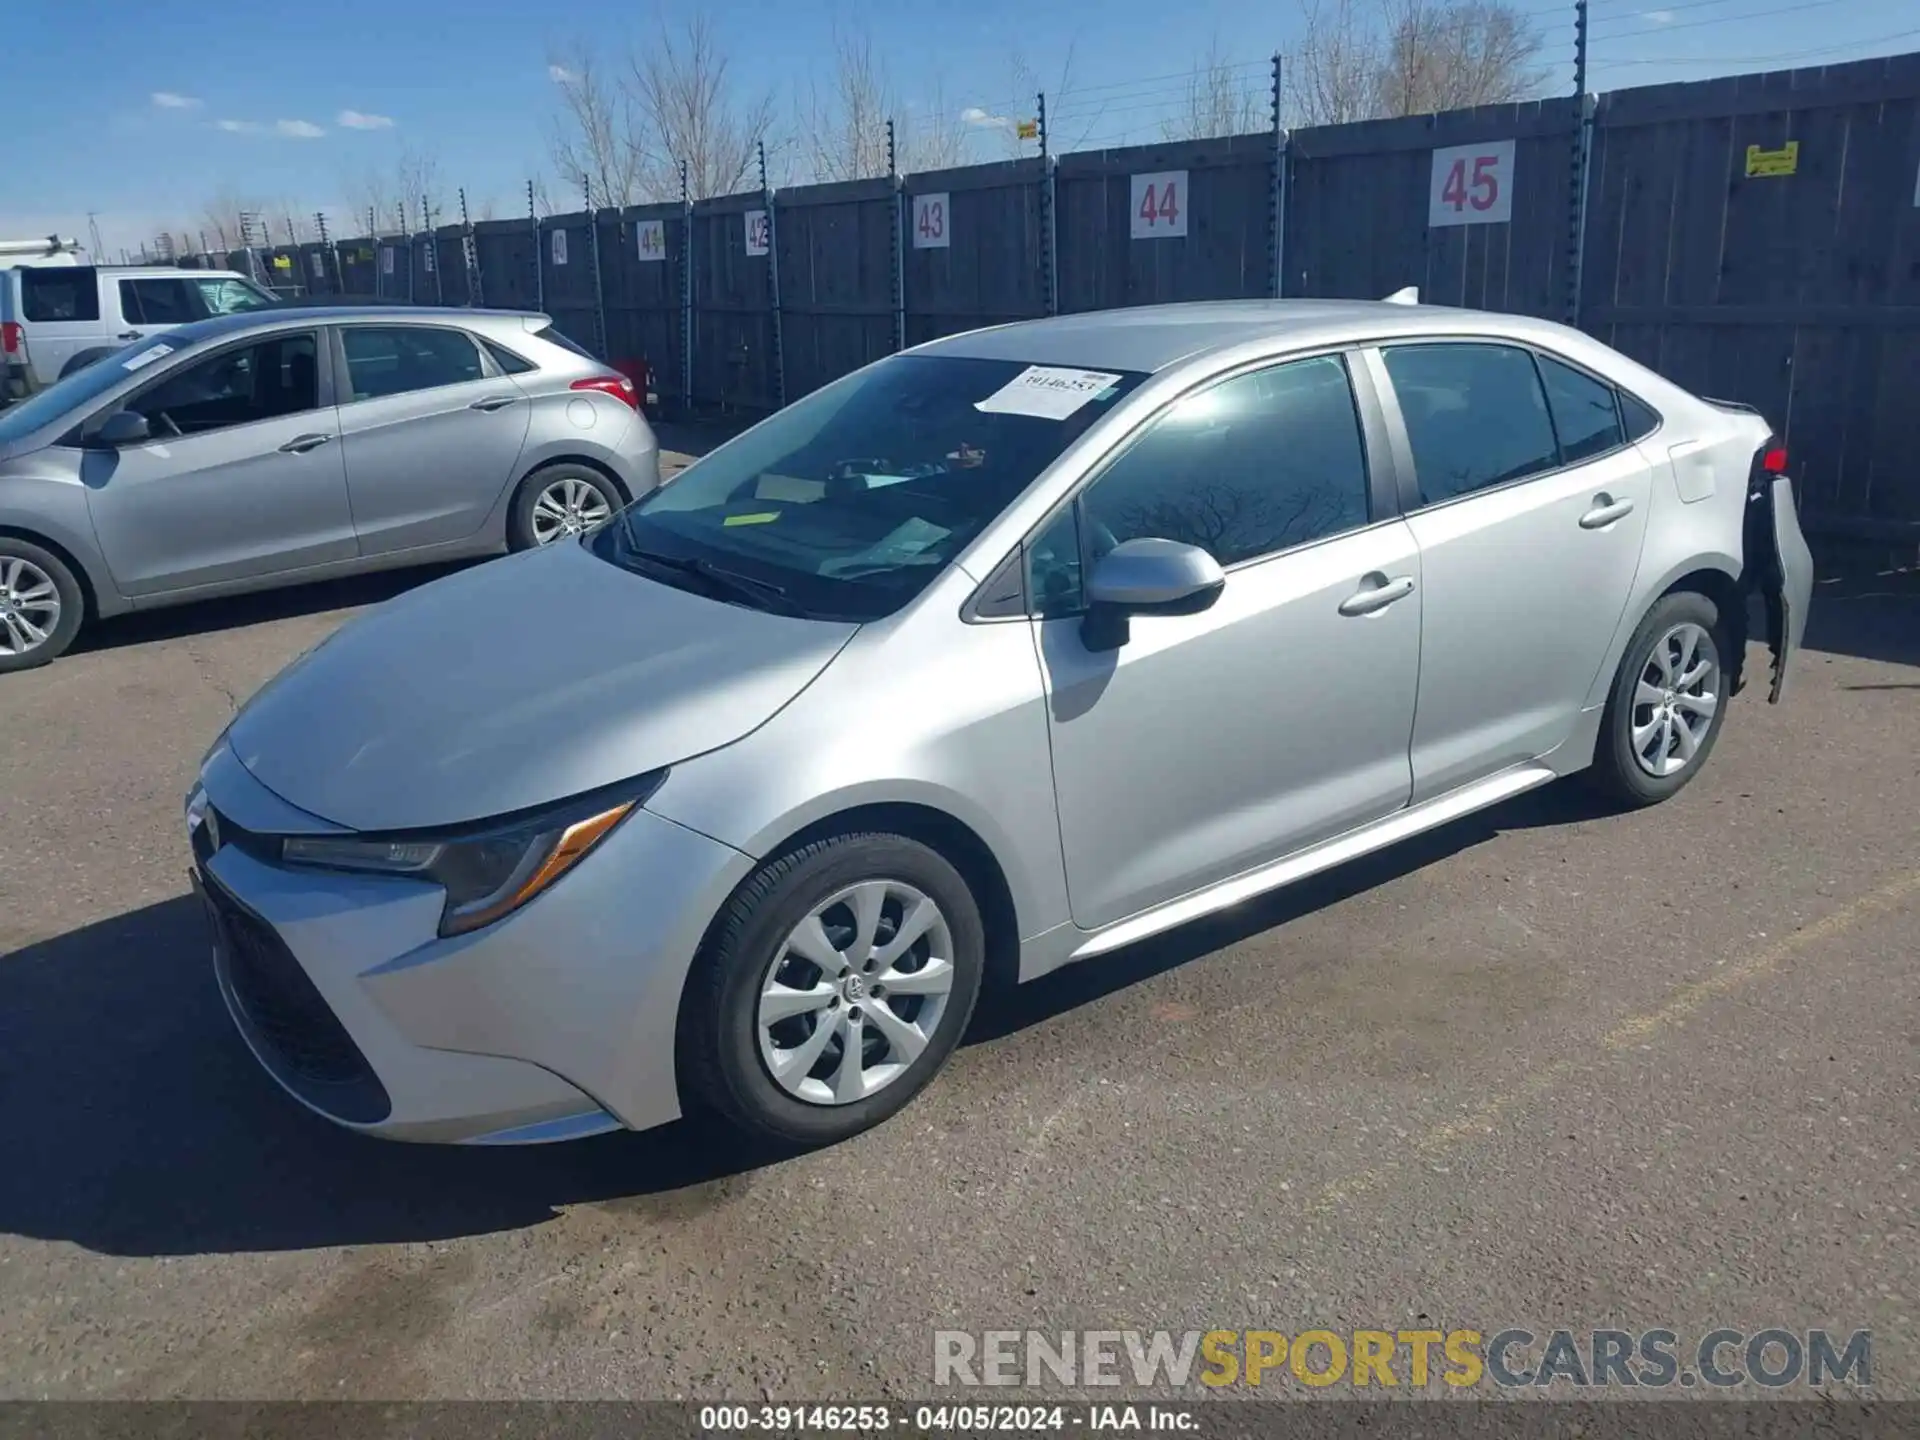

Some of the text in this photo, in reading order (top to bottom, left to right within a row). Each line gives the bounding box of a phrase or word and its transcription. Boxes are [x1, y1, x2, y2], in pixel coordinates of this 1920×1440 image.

[1139, 182, 1179, 226] 44
[1441, 156, 1499, 212] 45
[918, 203, 943, 239] 43
